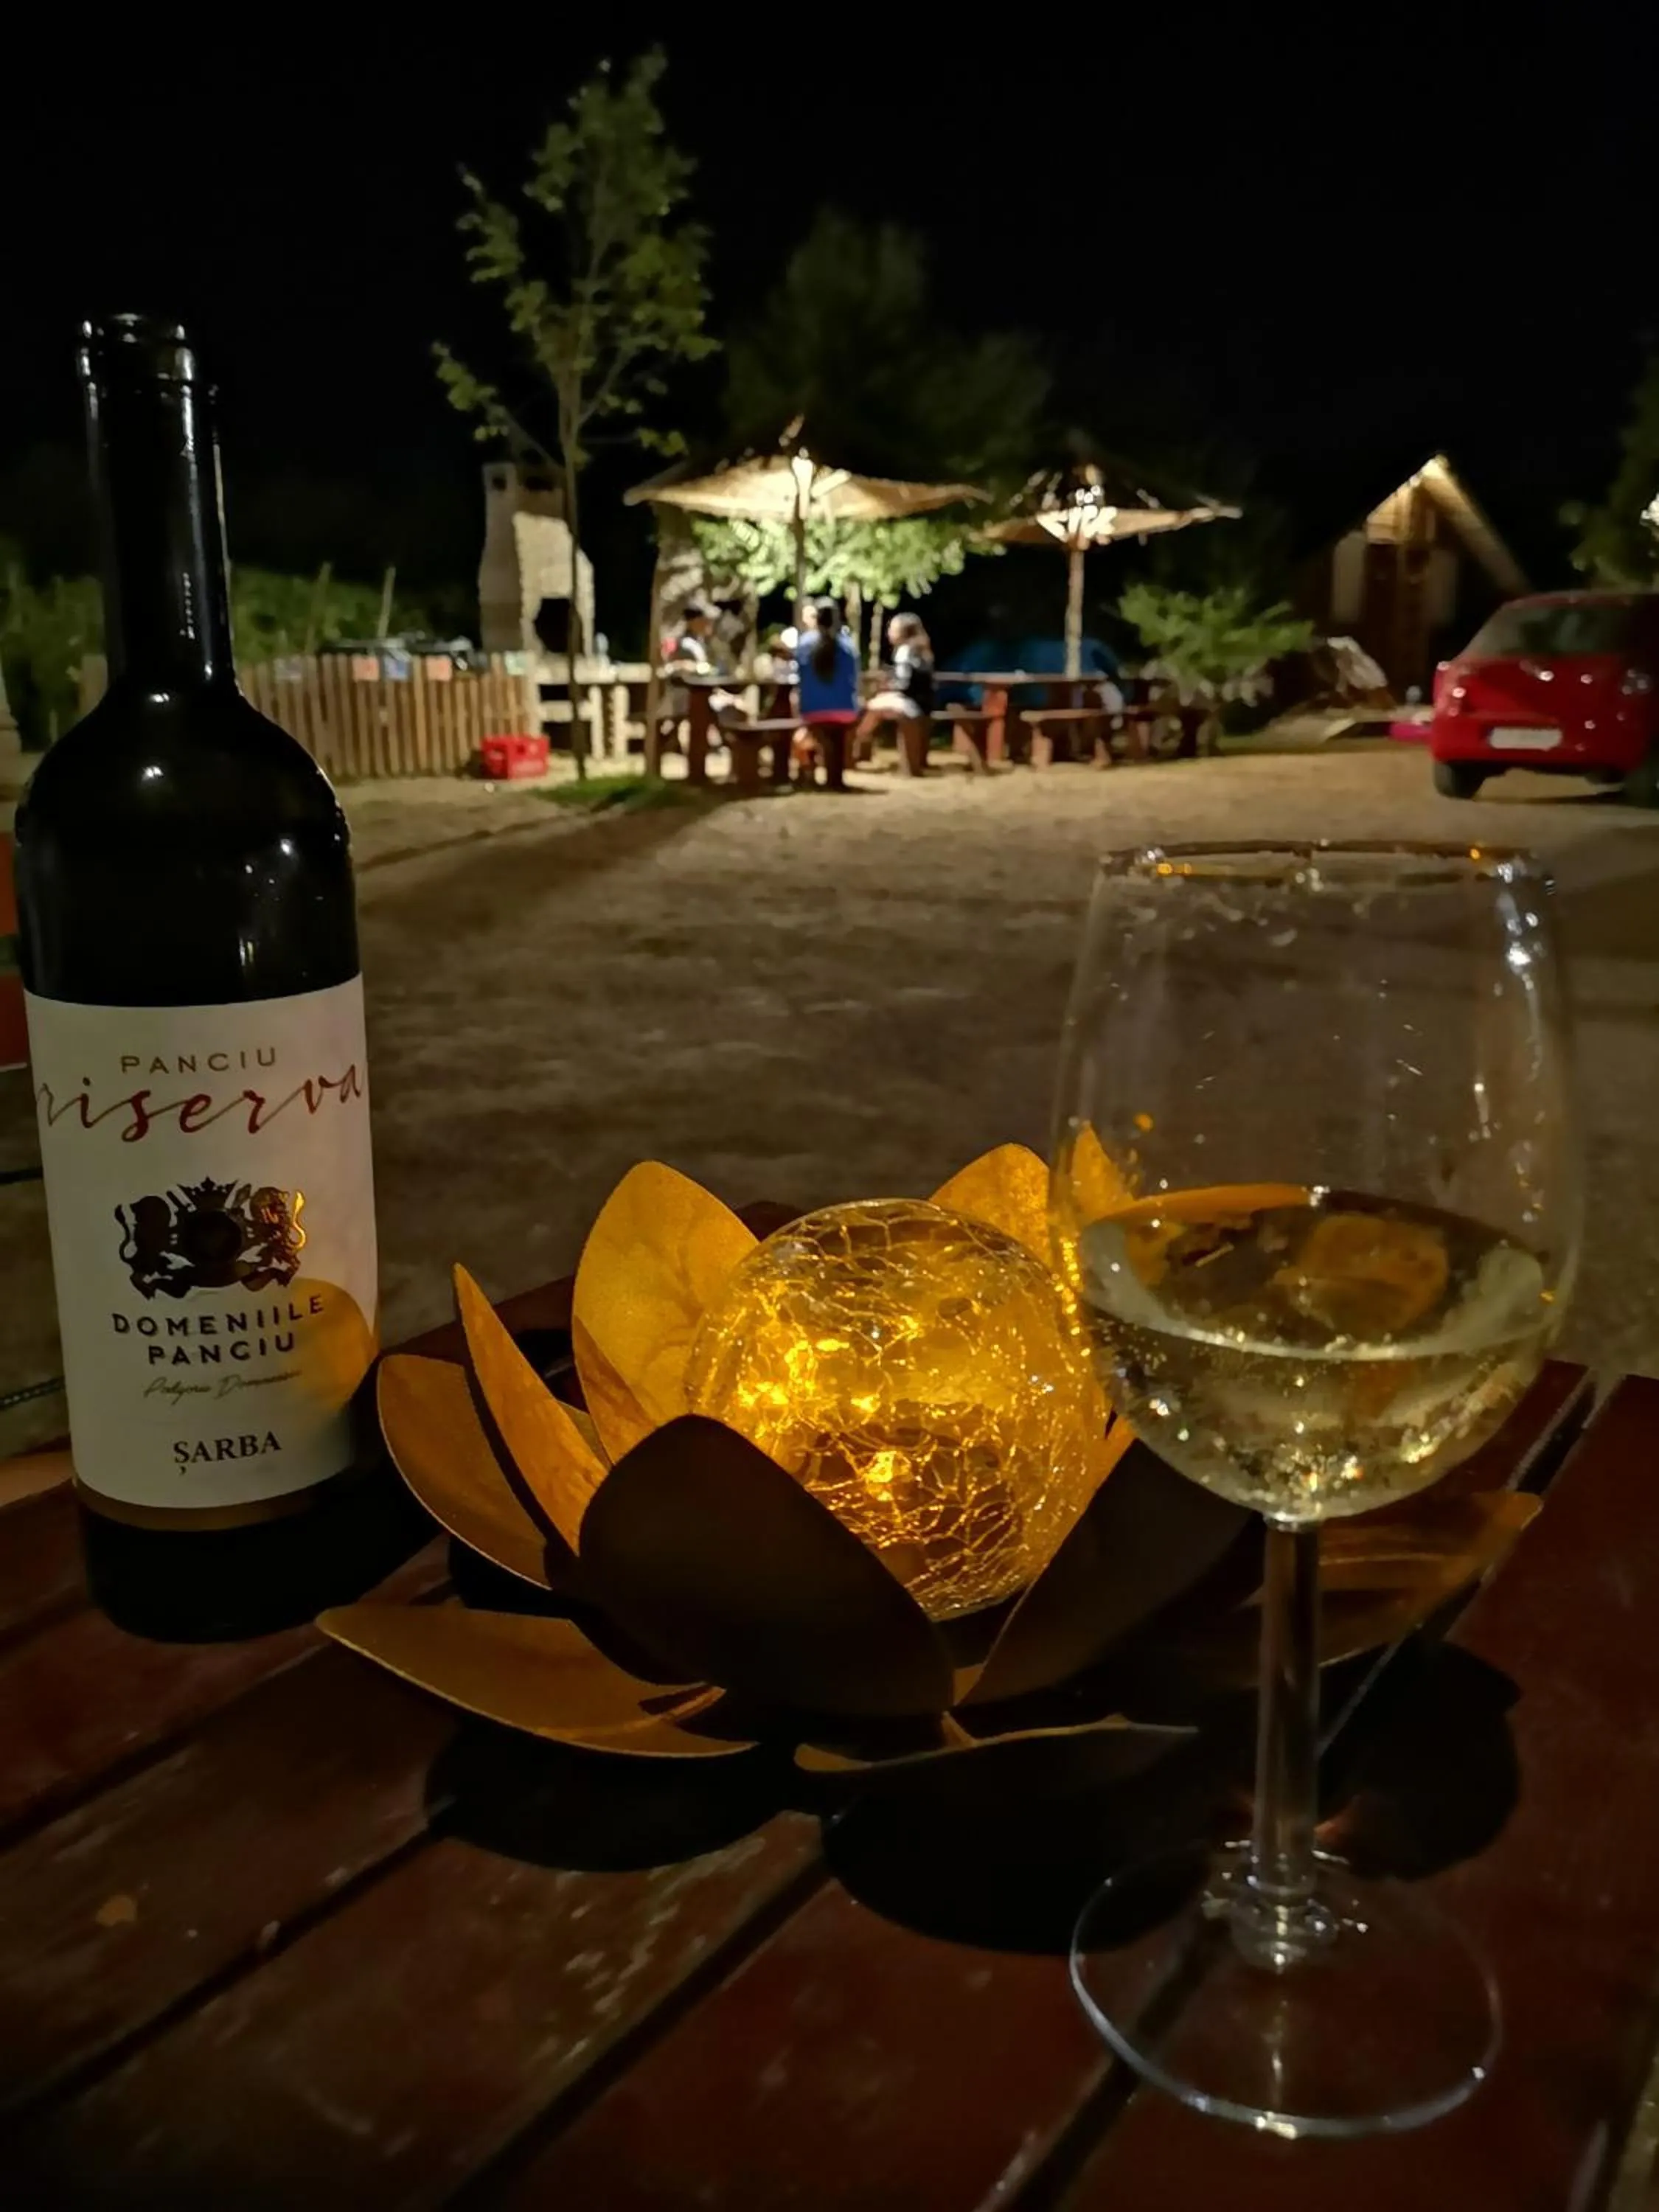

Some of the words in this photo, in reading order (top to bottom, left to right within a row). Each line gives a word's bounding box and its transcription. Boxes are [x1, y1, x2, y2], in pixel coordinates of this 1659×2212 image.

[120, 1047, 276, 1074] PANCIU
[37, 1064, 361, 1142] riserva
[111, 1294, 324, 1336] DOMENIILE
[148, 1332, 294, 1366] PANCIU
